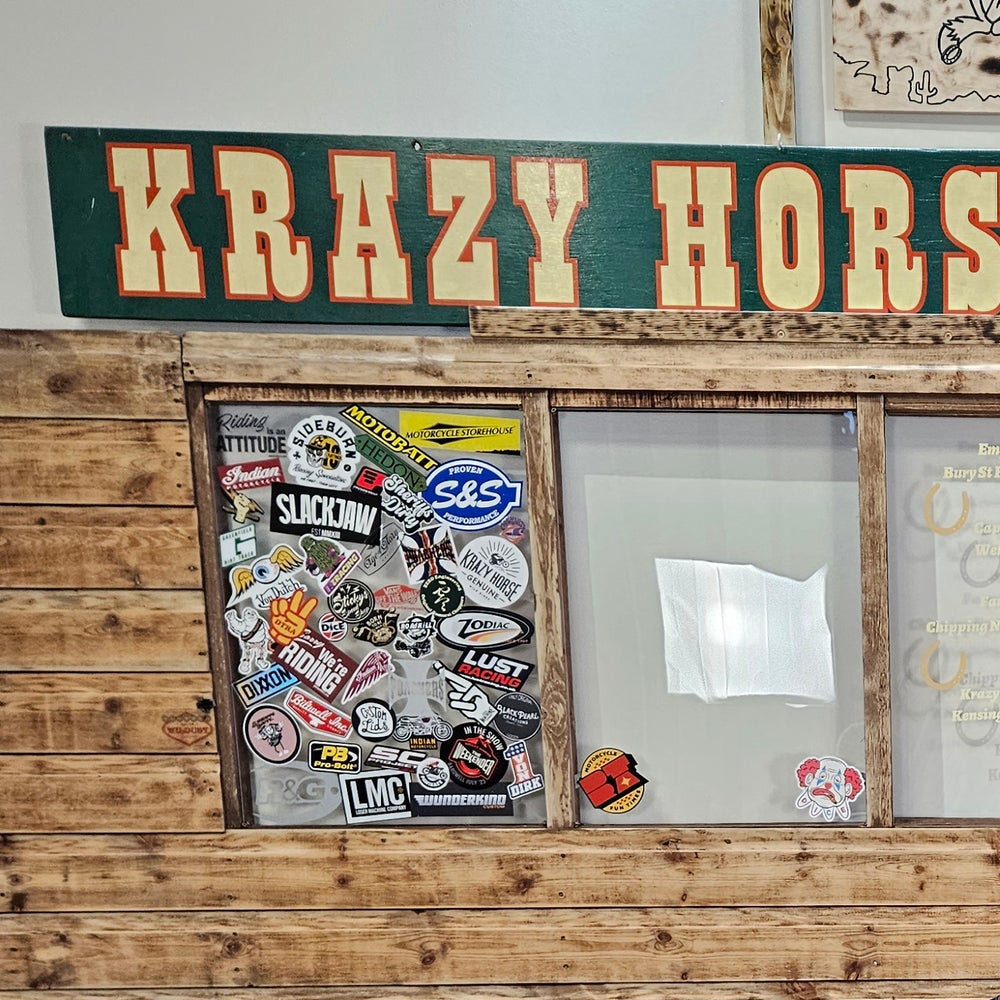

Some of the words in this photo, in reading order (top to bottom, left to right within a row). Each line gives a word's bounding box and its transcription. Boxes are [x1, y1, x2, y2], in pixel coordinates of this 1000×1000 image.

[104, 142, 588, 307] KRAZY
[216, 413, 269, 432] Riding
[406, 428, 460, 438] MOTORCYCLE
[462, 426, 514, 436] STOREHOUSE
[216, 435, 287, 453] ATTITUDE
[292, 419, 356, 459] SIDEBURN
[346, 405, 438, 470] MOTOBATT
[362, 437, 421, 488] HEDON
[449, 466, 483, 475] PROVEN
[943, 466, 976, 481] Bury
[978, 465, 993, 478] St
[221, 465, 282, 486] Indian
[431, 480, 504, 509] S&S
[275, 493, 377, 535] SLACKJAW
[443, 509, 500, 524] PERFORMANCE
[460, 549, 493, 578] KRAZY
[490, 572, 521, 601] HORSE
[256, 591, 274, 608] Von
[272, 578, 301, 599] Dutch
[467, 574, 500, 599] GENUINE
[274, 619, 297, 635] DTRA
[458, 618, 510, 639] ZODIAC
[926, 621, 988, 638] Chipping
[278, 641, 342, 696] RIDING
[318, 647, 348, 677] We're
[463, 650, 529, 677] LUST
[241, 666, 291, 698] DIXXON
[458, 664, 521, 688] RACING
[960, 687, 1000, 703] Krazy
[361, 705, 387, 720] Custom
[497, 704, 517, 717] BLACK
[518, 711, 539, 720] PEARL
[362, 719, 388, 734] Lids
[463, 726, 473, 735] IN
[473, 726, 487, 737] THE
[486, 731, 505, 751] SHOW
[321, 746, 349, 762] PB
[370, 746, 427, 765] SC
[453, 742, 495, 776] WEEKENDER
[585, 751, 618, 773] MOTORCYCLE
[259, 776, 325, 806] R&G
[350, 777, 406, 810] LMC
[510, 777, 541, 797] DIRK
[414, 794, 507, 806] WUNDERKIND
[626, 790, 641, 807] TIMES
